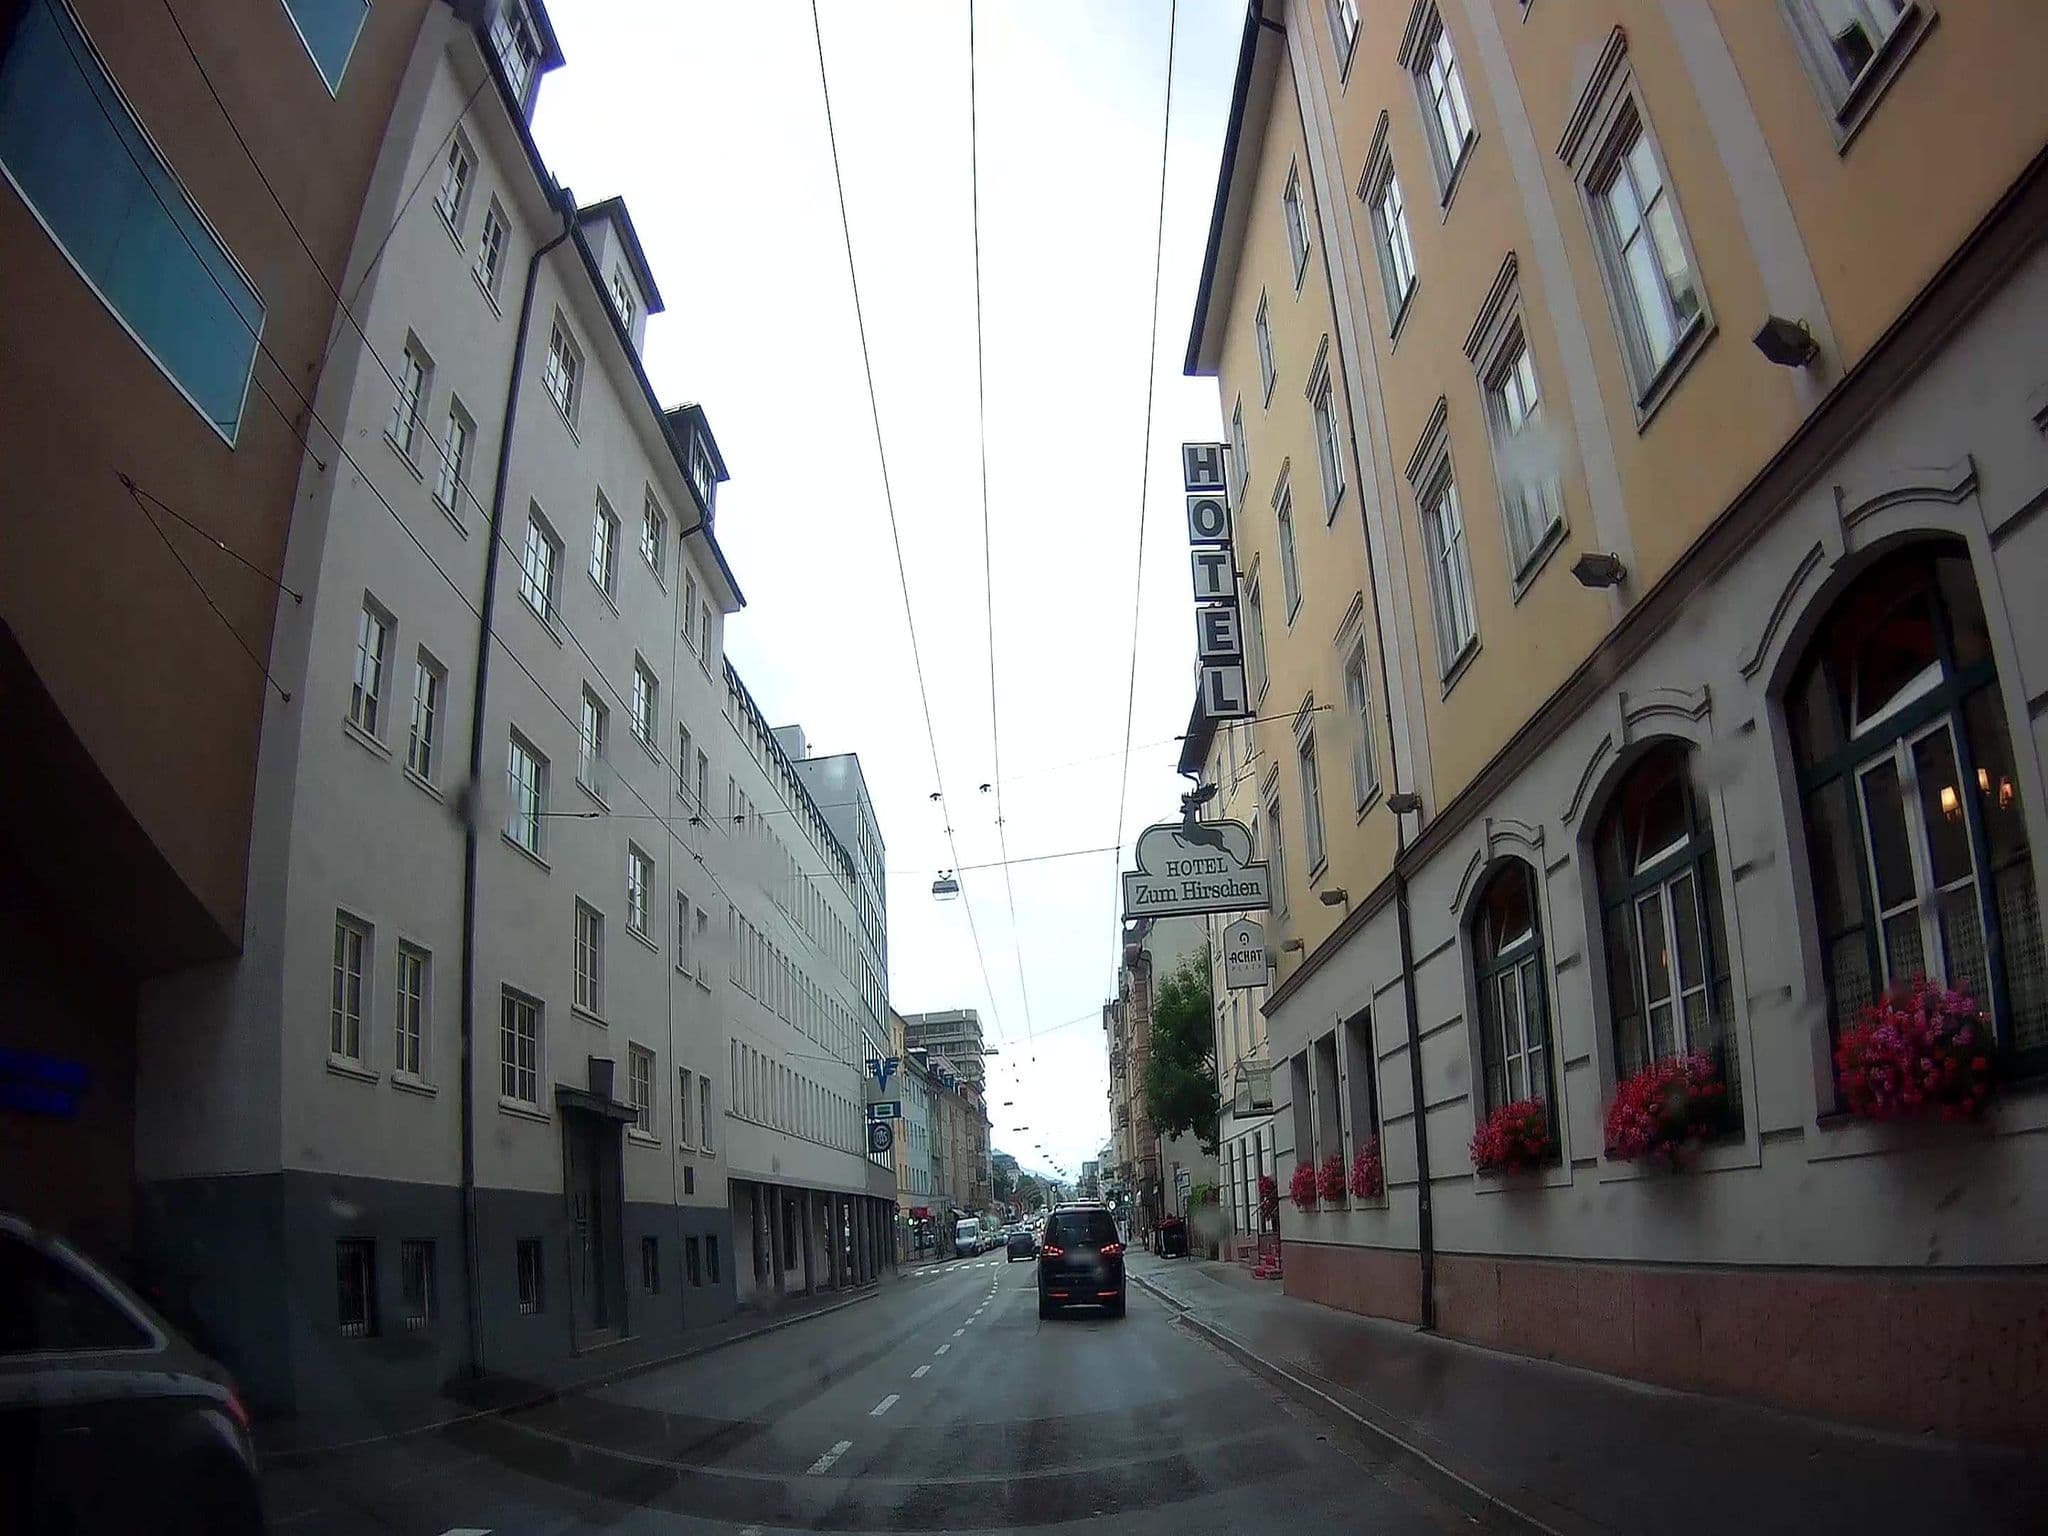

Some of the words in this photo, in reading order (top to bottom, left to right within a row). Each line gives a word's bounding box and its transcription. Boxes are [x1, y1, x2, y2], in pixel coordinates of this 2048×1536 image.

[1187, 446, 1239, 712] HOTEL
[1166, 858, 1228, 877] HOTEL
[1136, 885, 1178, 904] Zum
[1181, 879, 1261, 900] Hirschen
[1229, 949, 1263, 964] ACHAT
